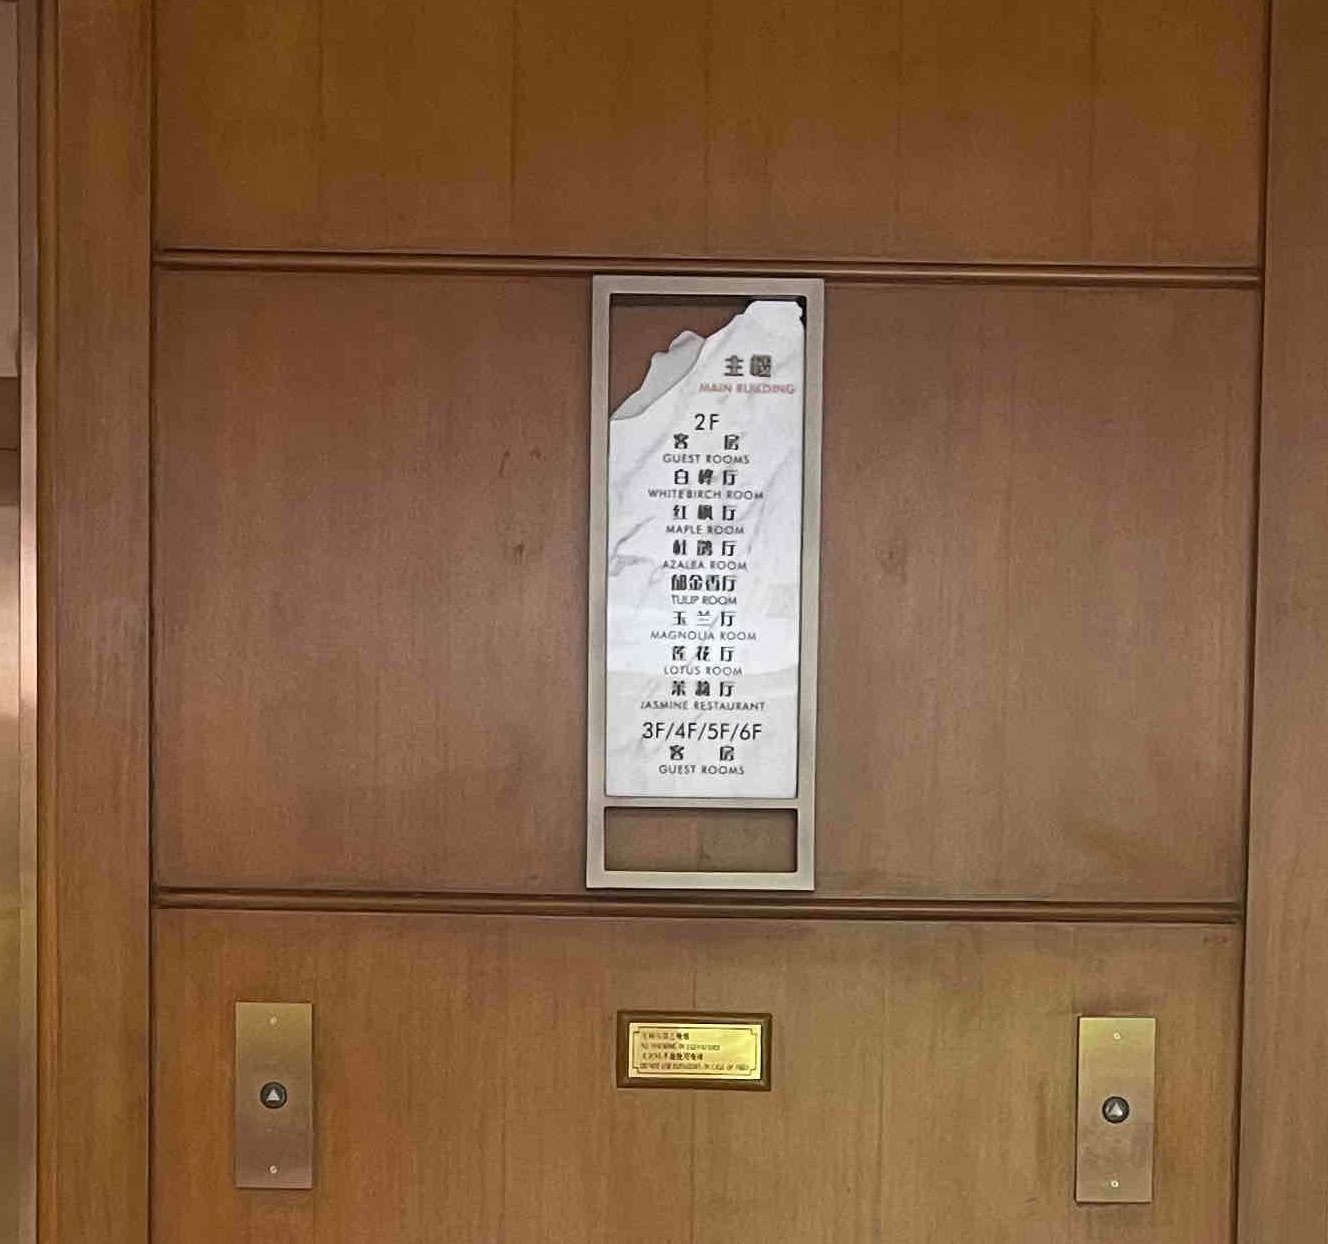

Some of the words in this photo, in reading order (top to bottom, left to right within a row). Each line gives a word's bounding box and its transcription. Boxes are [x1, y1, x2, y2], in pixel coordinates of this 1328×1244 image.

[698, 383, 732, 394] MAIN
[736, 383, 795, 395] BUILDING
[694, 413, 721, 431] 2F
[662, 453, 701, 464] GUEST
[705, 454, 750, 465] ROOMS
[647, 488, 722, 500] WHITEBIRCH
[726, 490, 764, 501] ROOM
[665, 524, 704, 535] MAPLE
[707, 525, 745, 536] ROOM
[662, 560, 705, 570] AZALEA
[709, 560, 747, 571] ROOM
[671, 574, 737, 592] 郁金香厅
[671, 594, 699, 605] TULIP
[701, 595, 738, 606] ROOM
[650, 630, 715, 641] MAGNOLIA
[719, 631, 757, 641] ROOM
[664, 665, 701, 676] LOTUS
[705, 666, 743, 677] ROOM
[693, 701, 766, 711] RESTAURANT
[641, 721, 763, 742] 3F/4F/5F/6F
[658, 764, 697, 775] GUEST
[701, 765, 745, 775] ROOMS
